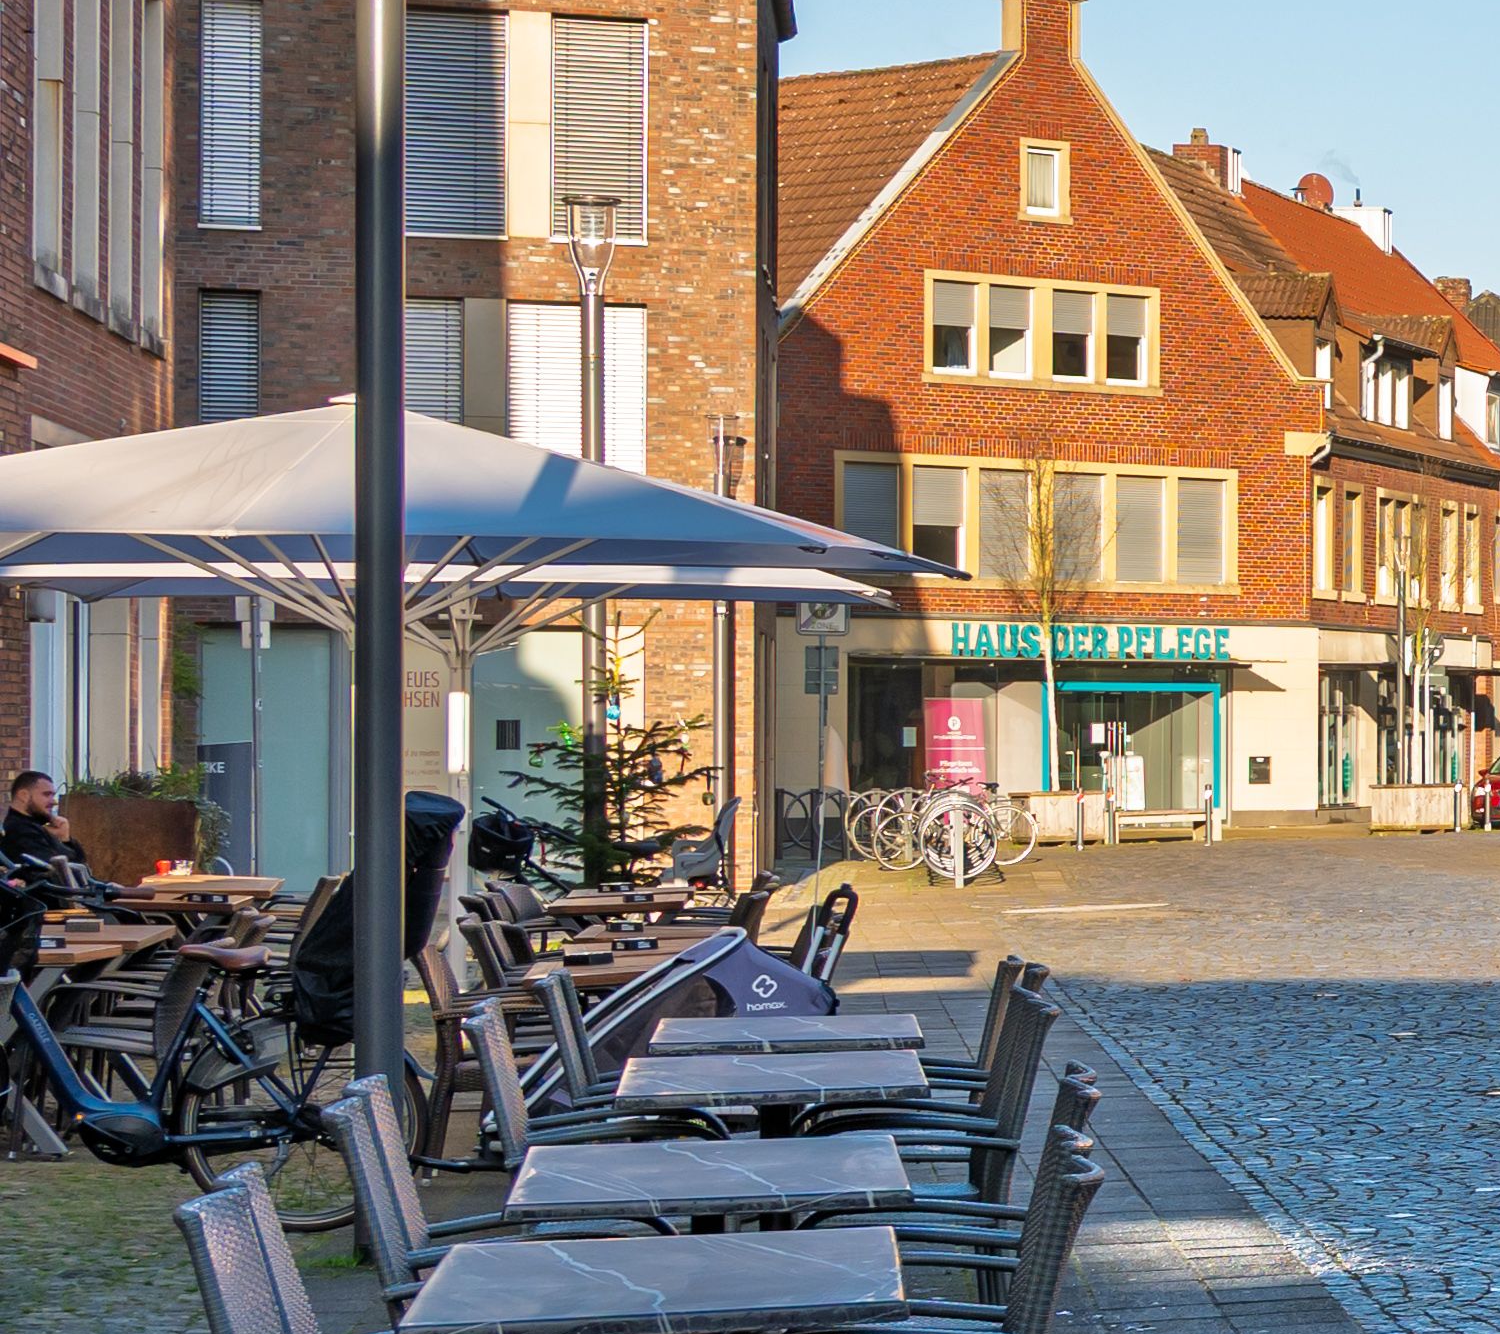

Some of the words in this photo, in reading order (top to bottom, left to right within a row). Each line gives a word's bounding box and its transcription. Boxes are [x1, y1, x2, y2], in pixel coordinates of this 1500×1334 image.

[951, 622, 1041, 658] HAUS
[1050, 624, 1109, 659] DER
[1117, 626, 1231, 660] PFLEGE
[406, 671, 439, 687] EUES
[404, 691, 439, 707] HSEN
[746, 1001, 786, 1011] hamax
